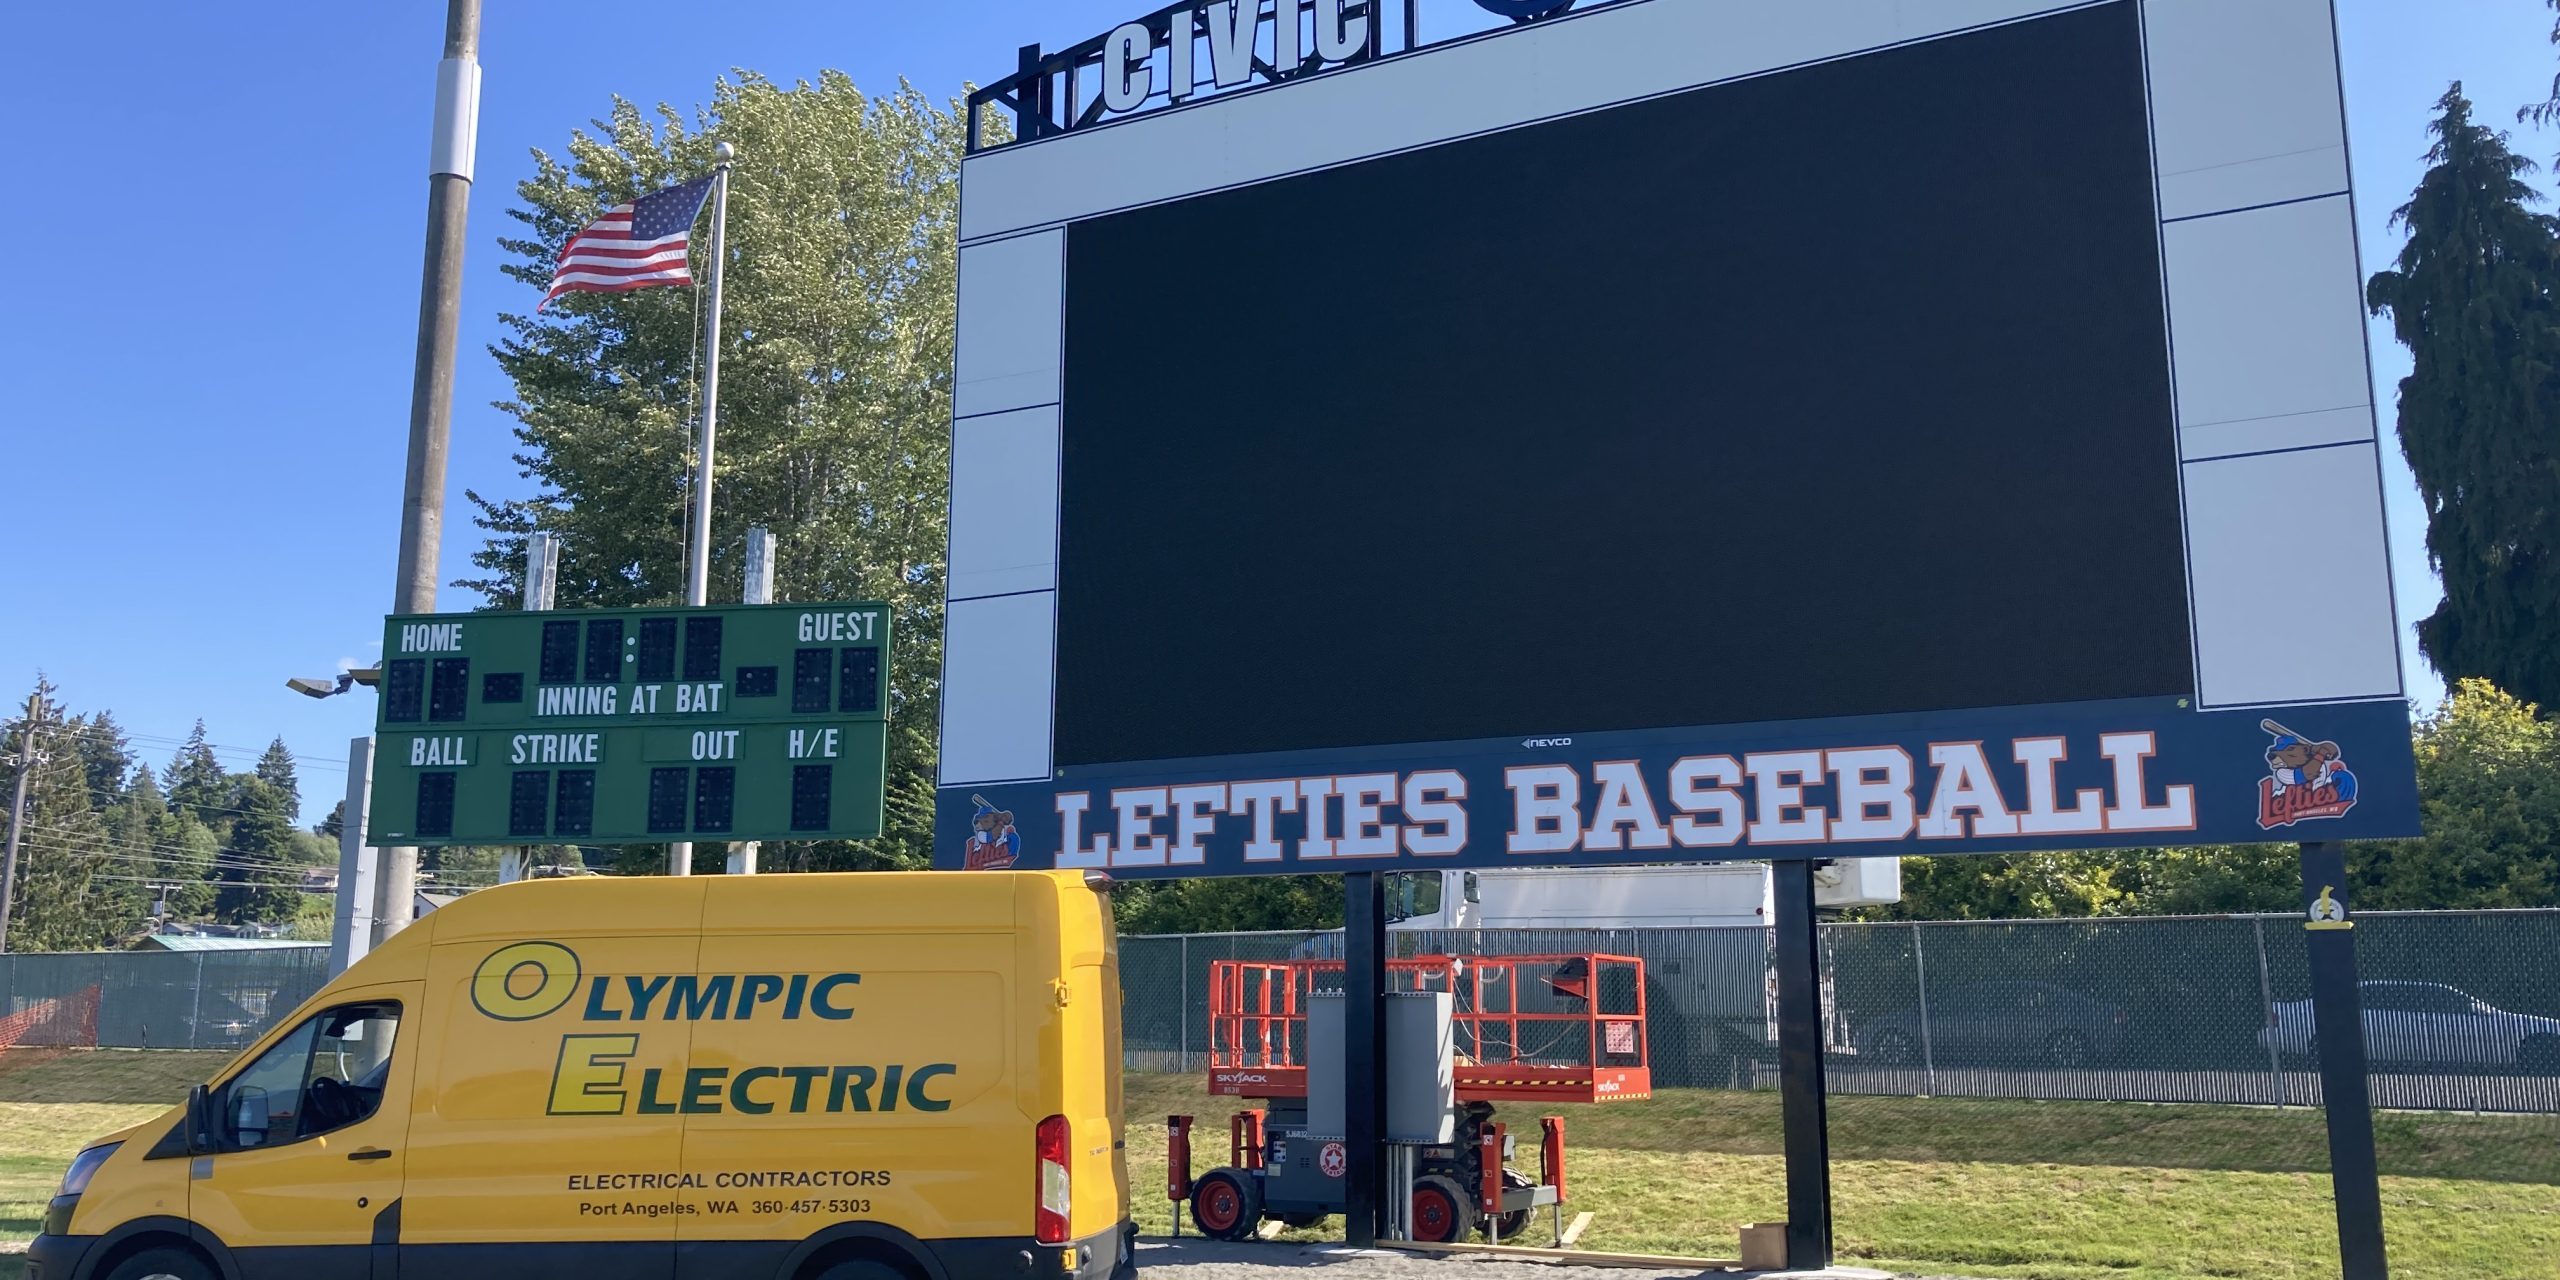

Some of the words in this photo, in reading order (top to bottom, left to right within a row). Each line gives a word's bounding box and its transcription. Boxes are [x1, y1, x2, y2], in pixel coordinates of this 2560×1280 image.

[1103, 0, 1369, 113] CIVIC
[402, 624, 463, 652] HOME
[798, 612, 877, 642] GUEST
[537, 685, 617, 716] INNING
[630, 684, 661, 713] AT
[676, 683, 725, 712] BAT
[410, 736, 468, 766] BALL
[511, 733, 599, 763] STRIKE
[691, 730, 740, 760] OUT
[788, 728, 838, 758] H/E
[1056, 770, 1468, 867] LEFTIES
[1505, 731, 2197, 854] BASEBALL
[2259, 778, 2339, 828] Lefties
[470, 940, 861, 1022] OLYMPIC
[546, 1033, 957, 1116] ELECTRIC
[1216, 1071, 1267, 1083] SKYJACK
[568, 1174, 708, 1191] ELECTRICAL
[715, 1170, 892, 1188] CONTRACTORS
[579, 1202, 617, 1217] Port
[621, 1200, 700, 1218] Angeles,
[707, 1201, 739, 1215] WA
